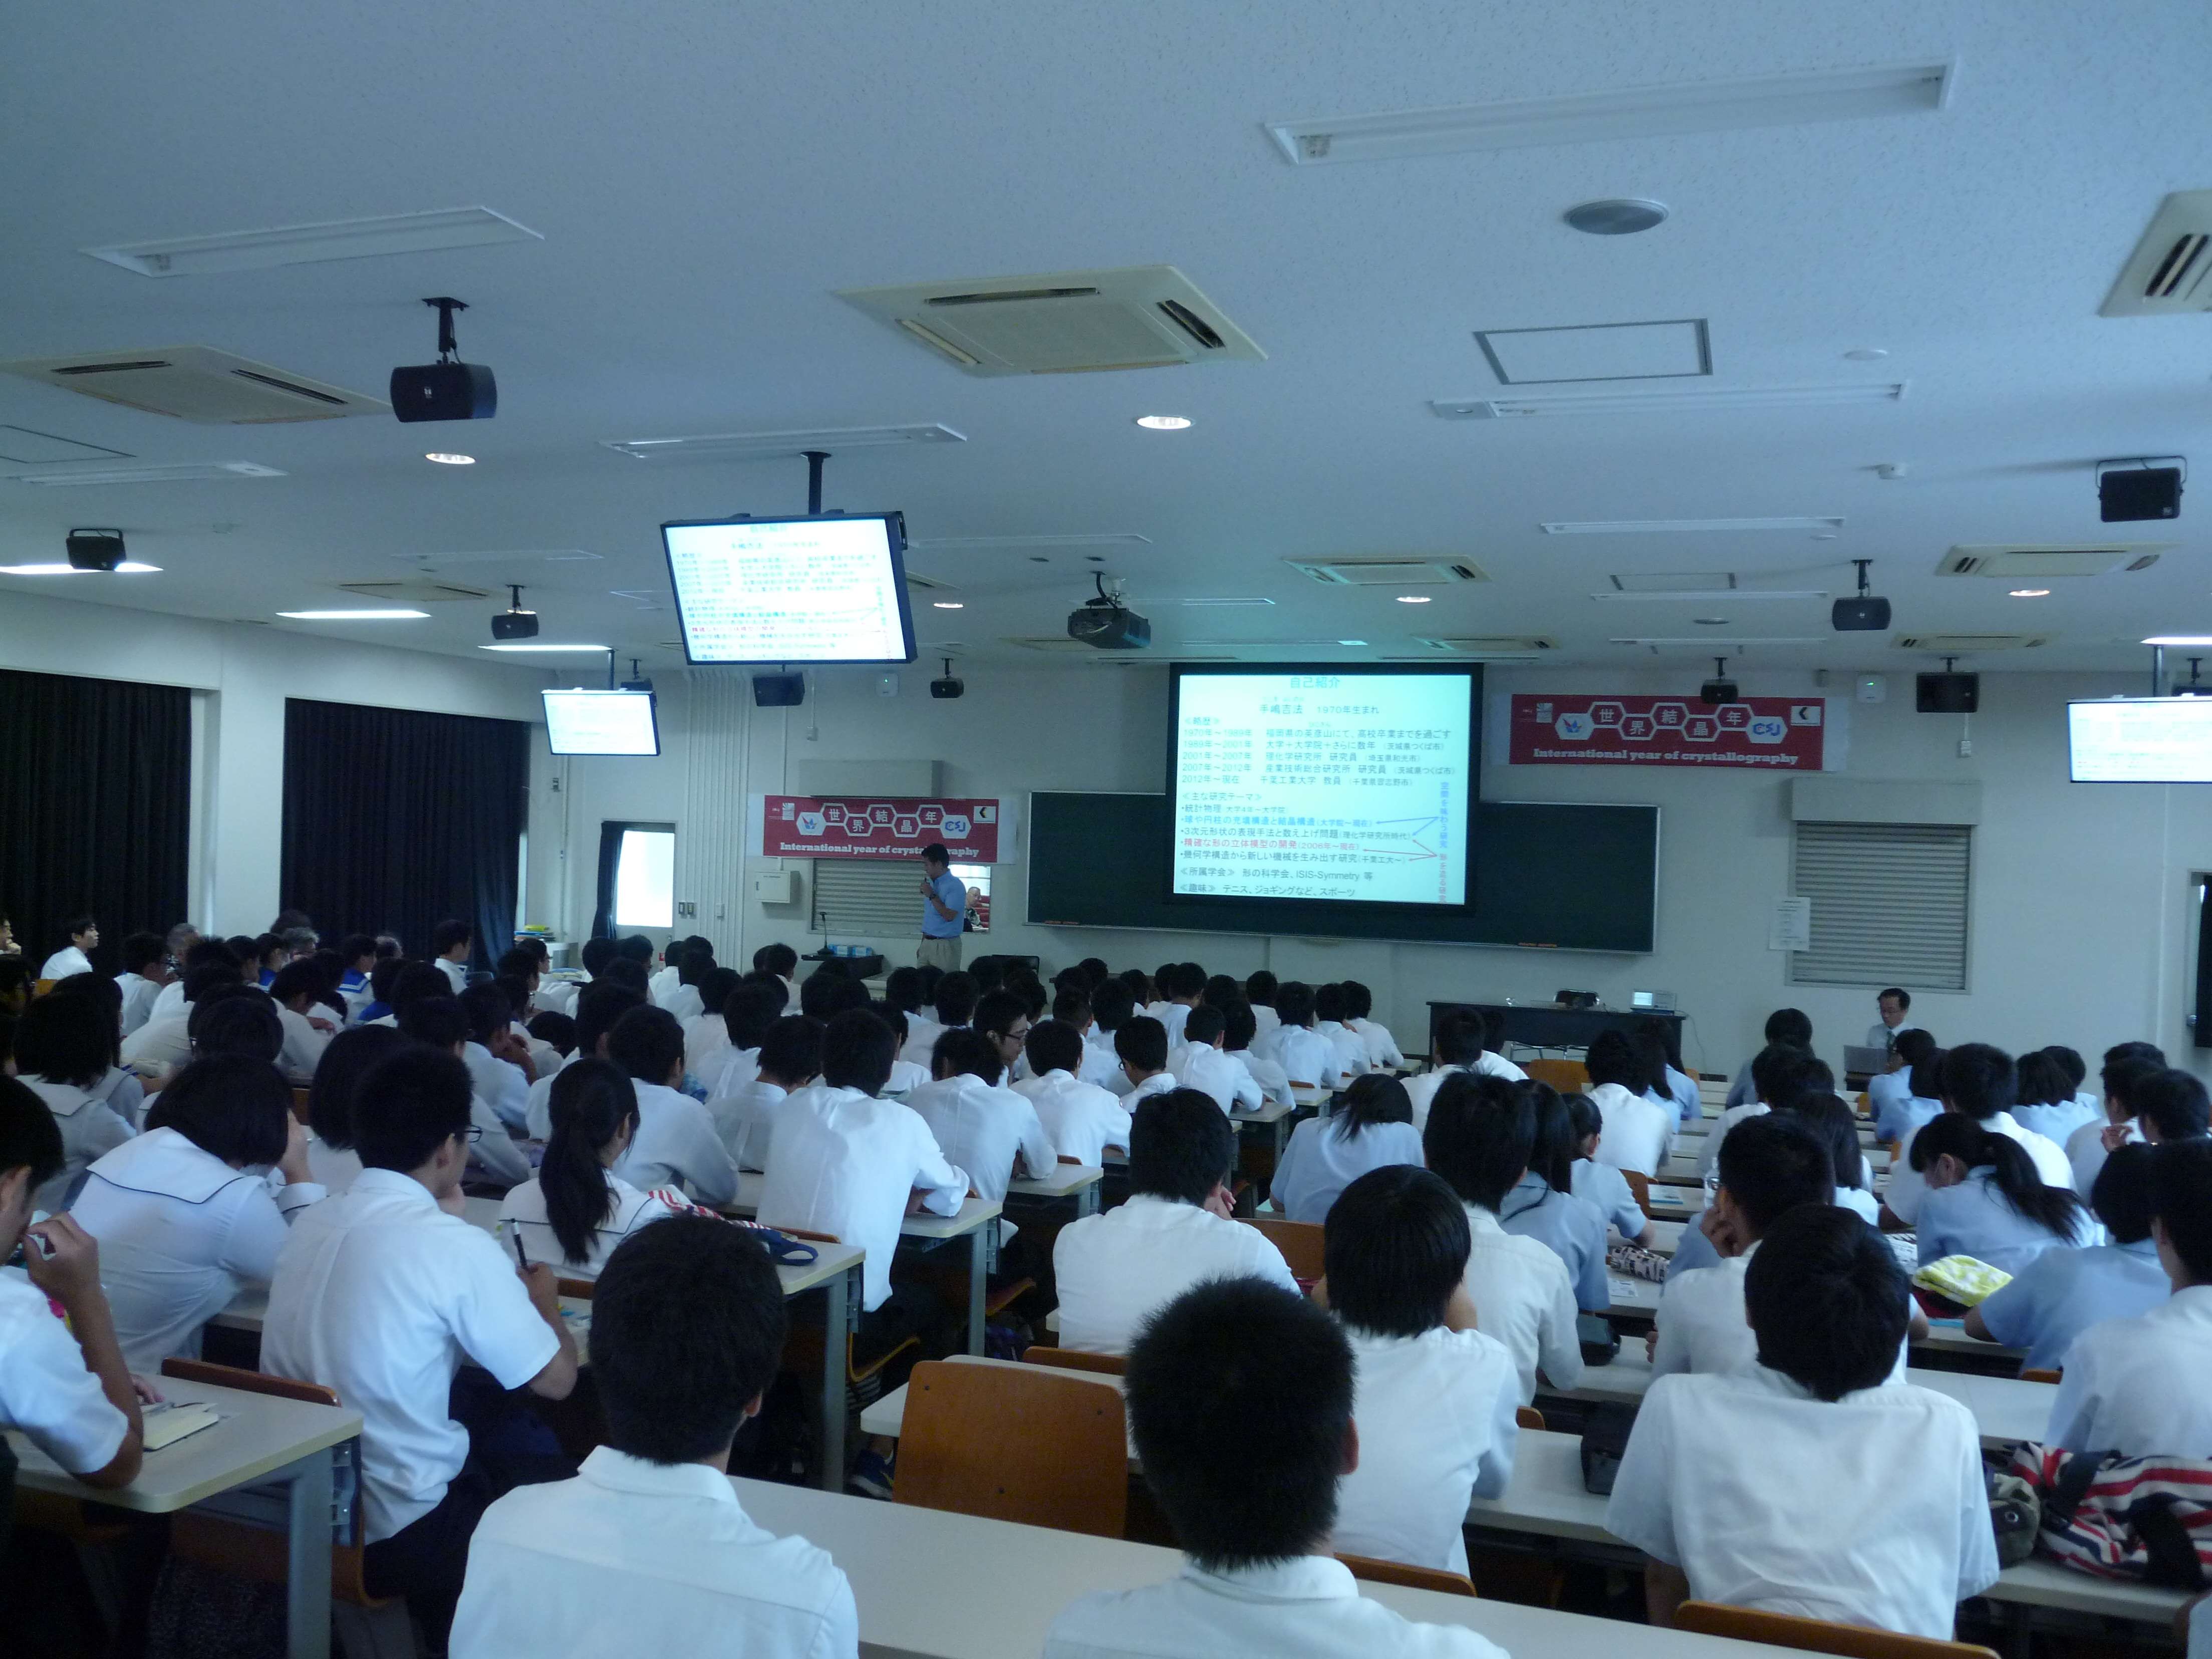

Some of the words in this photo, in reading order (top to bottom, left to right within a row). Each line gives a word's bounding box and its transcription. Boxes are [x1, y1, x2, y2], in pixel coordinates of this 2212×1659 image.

[1290, 677, 1340, 689] 自己紹介
[1316, 705, 1379, 714] 1970年生まれ
[1599, 708, 1742, 736] 世界結晶年
[1753, 723, 1781, 736] CSJ
[1266, 752, 1322, 761] 理化学研究所
[1329, 752, 1357, 761] 研究員
[1533, 748, 1627, 758] International
[1629, 752, 1662, 761] year
[1664, 751, 1680, 759] of
[1681, 751, 1799, 765] crystallography
[1358, 764, 1387, 774] 研究員
[828, 808, 937, 833] 世界結晶年
[780, 842, 852, 852] International
[853, 845, 879, 855] year
[879, 845, 891, 853] of
